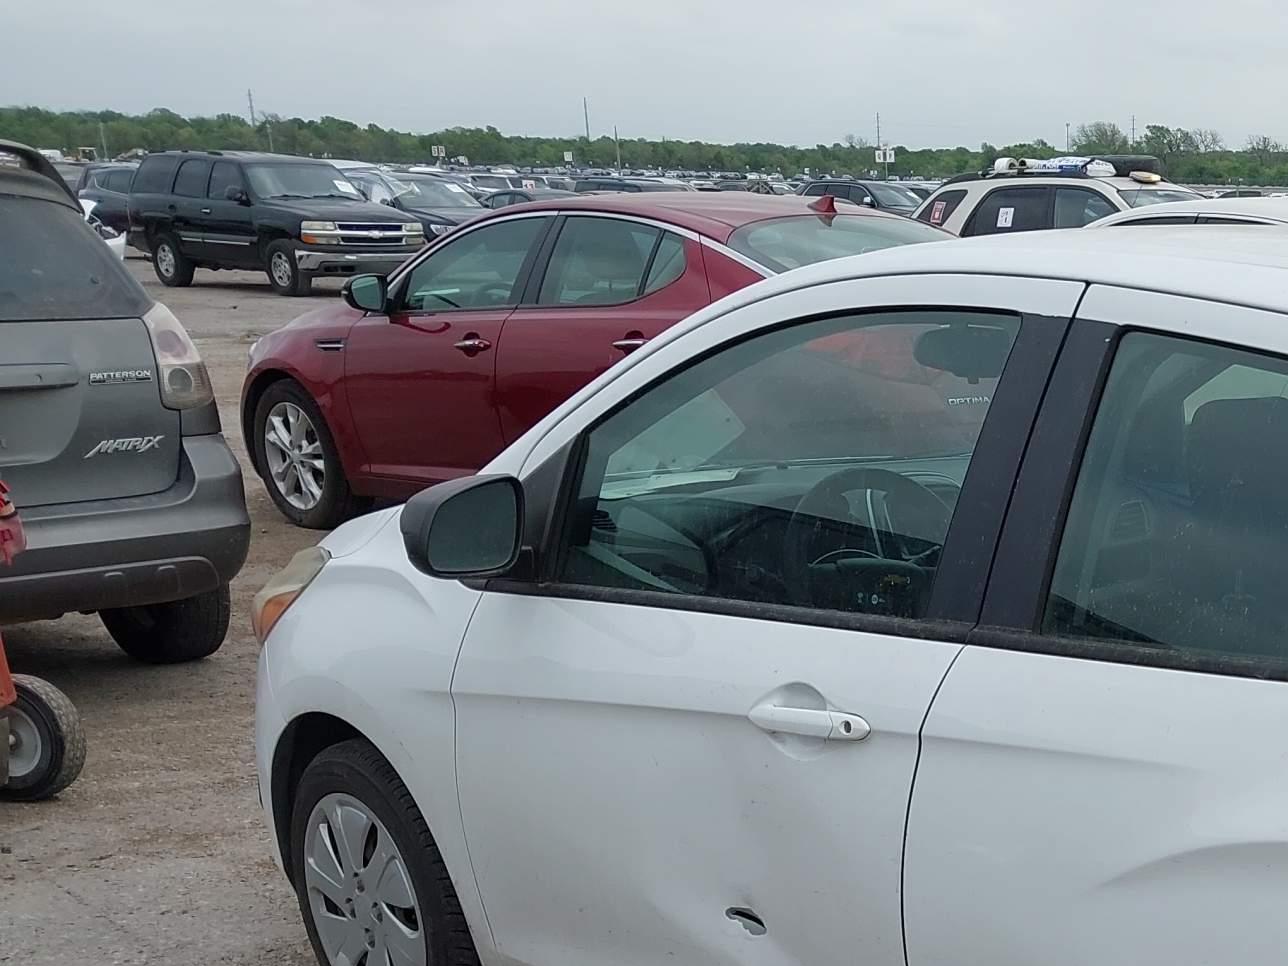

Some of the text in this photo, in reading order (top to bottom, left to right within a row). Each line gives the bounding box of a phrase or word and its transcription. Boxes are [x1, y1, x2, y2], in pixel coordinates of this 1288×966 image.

[90, 370, 151, 379] PATTERSON
[948, 396, 990, 405] OPTIMA
[83, 435, 165, 459] MATRIX
